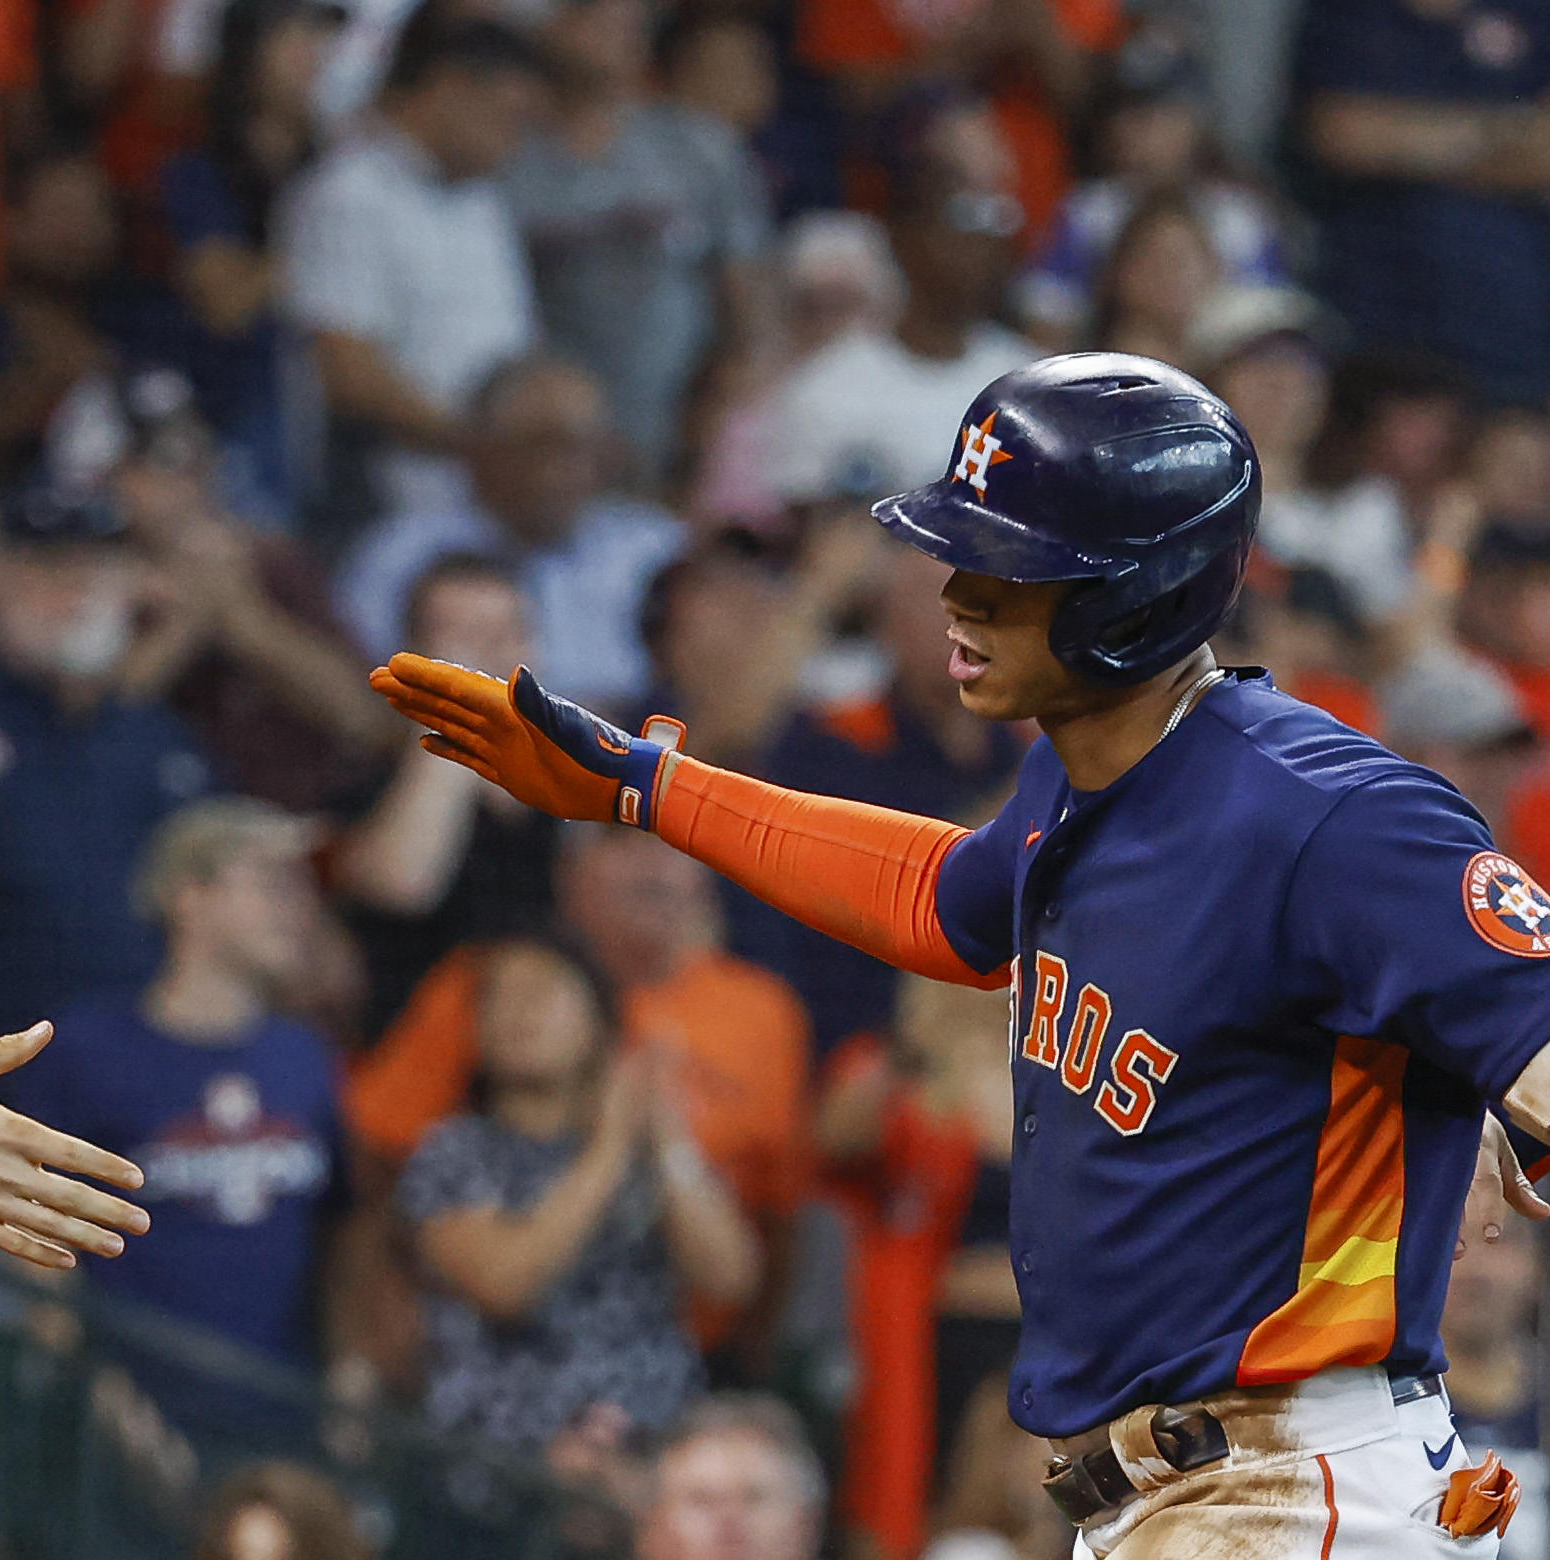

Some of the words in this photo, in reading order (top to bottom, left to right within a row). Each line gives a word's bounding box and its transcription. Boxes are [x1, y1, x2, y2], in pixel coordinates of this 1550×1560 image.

[954, 423, 1002, 492] H
[1470, 858, 1521, 911] HOUSTON
[1007, 949, 1180, 1137] ROS
